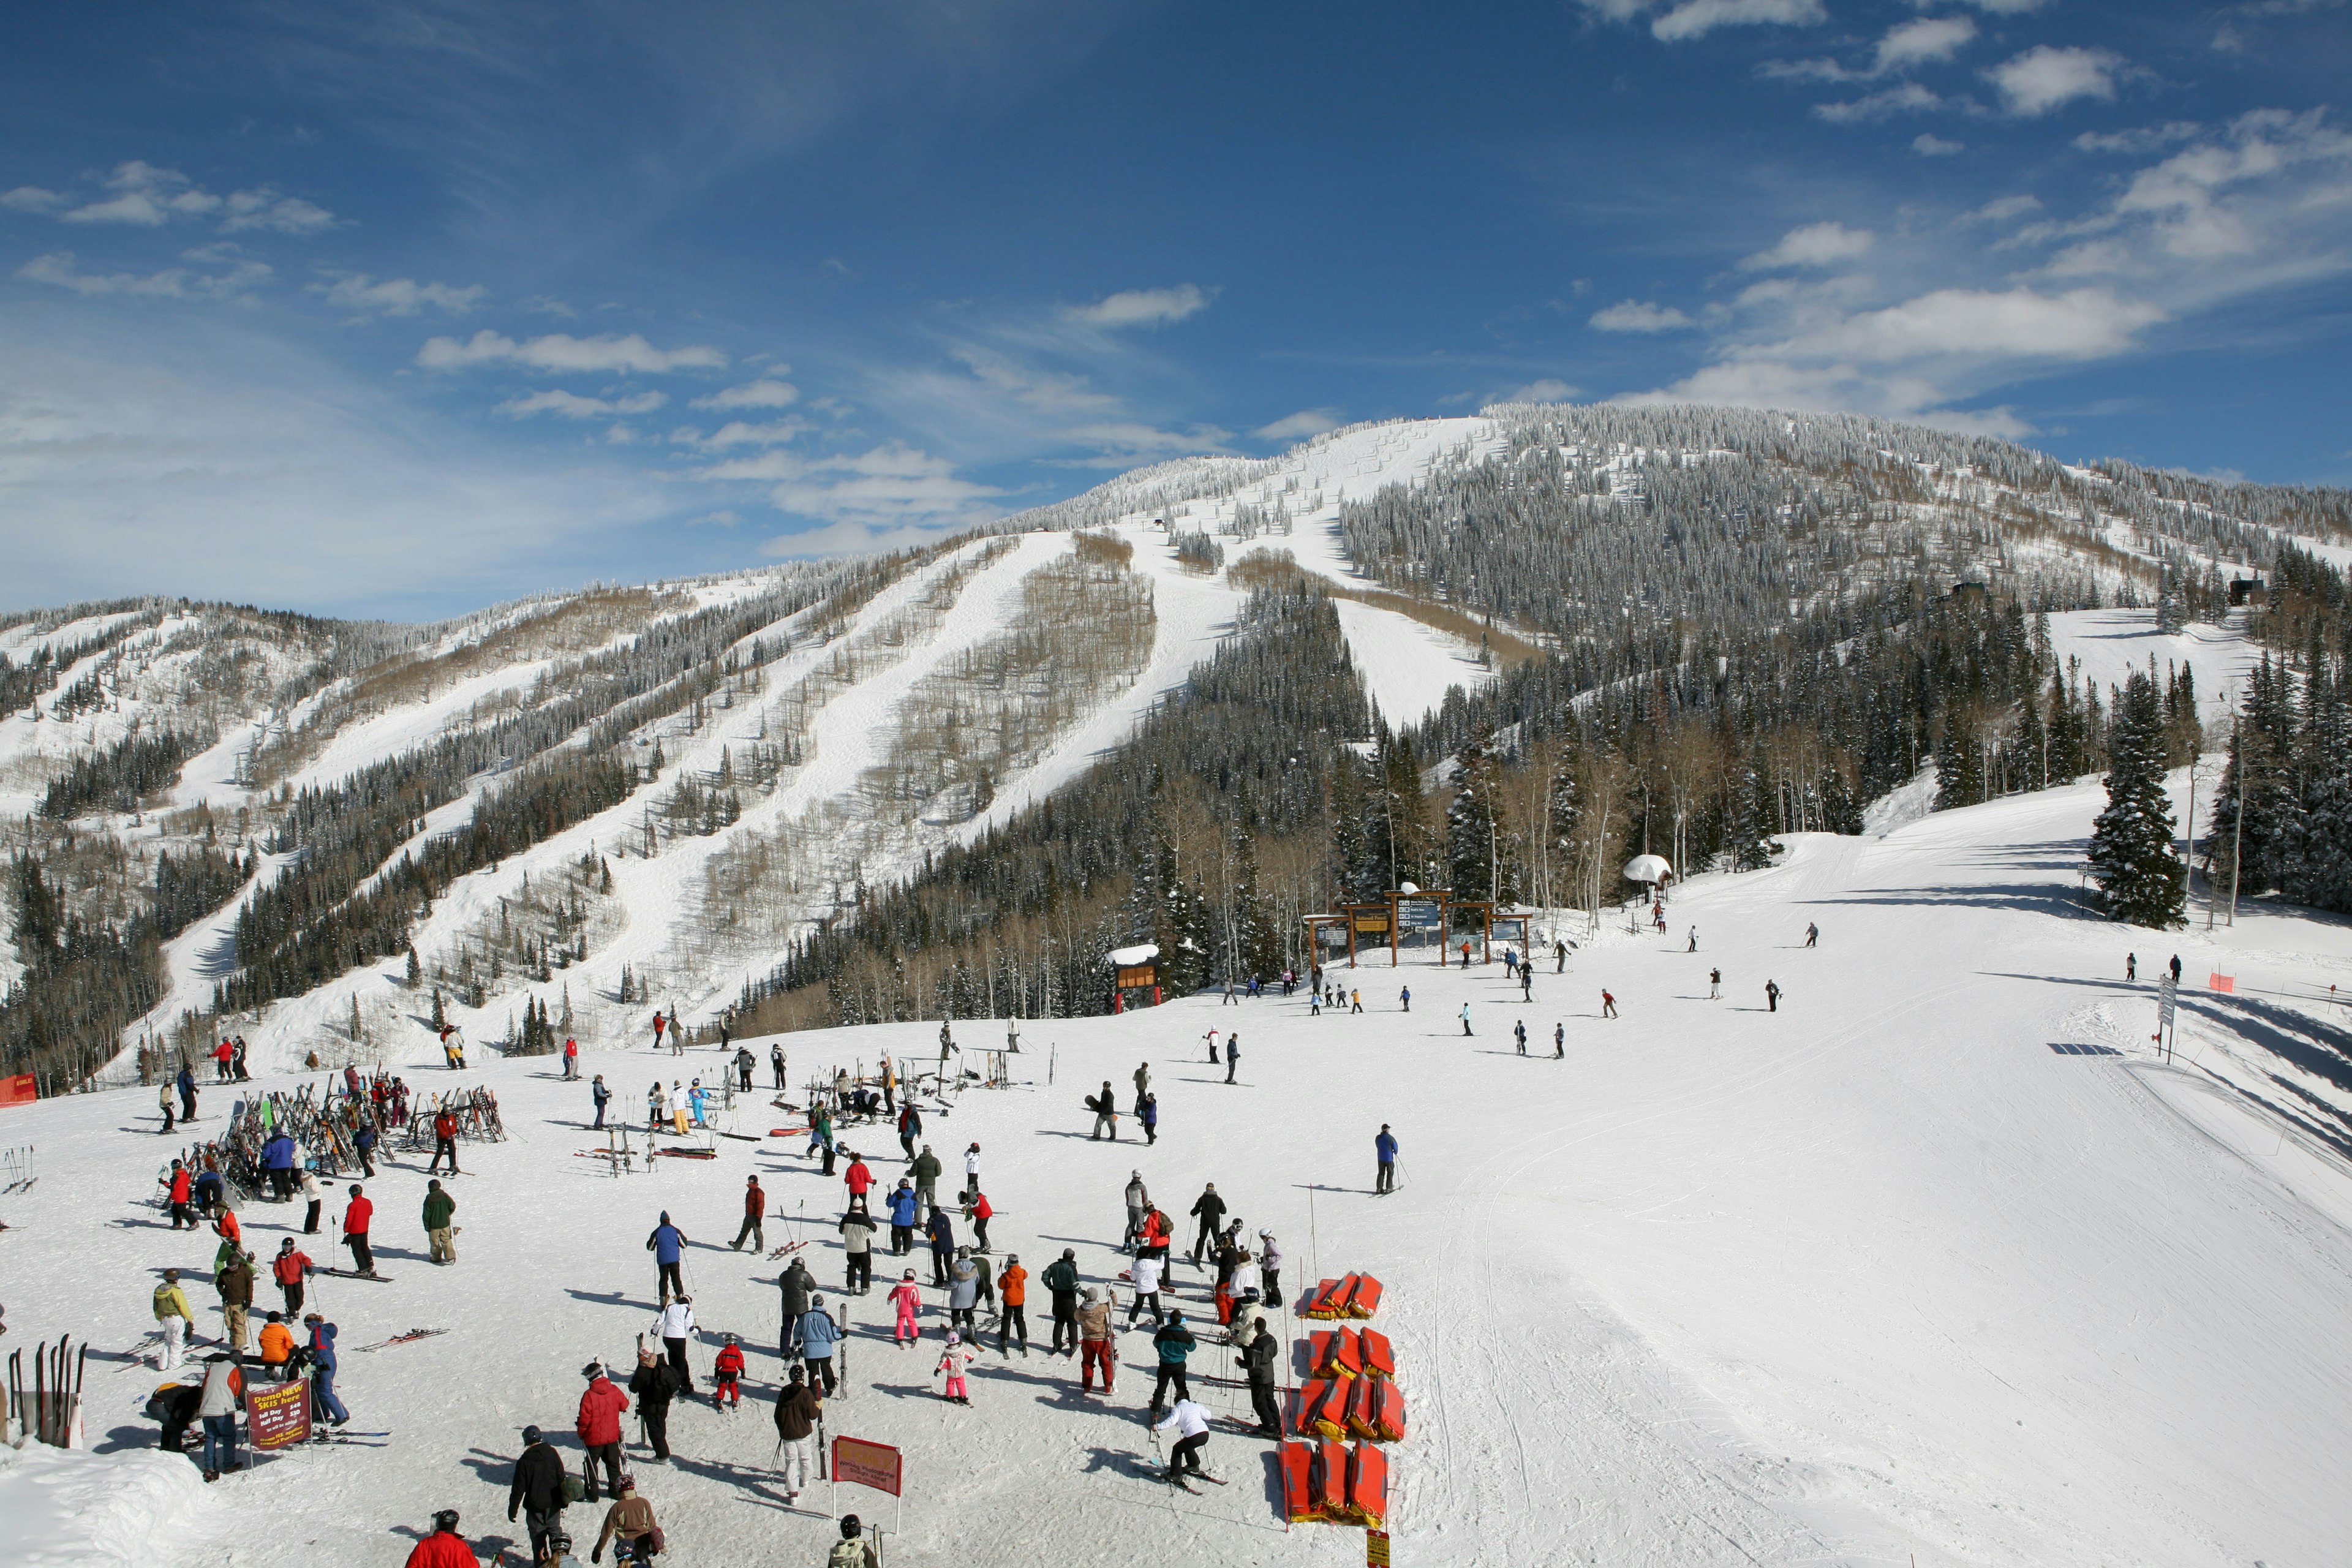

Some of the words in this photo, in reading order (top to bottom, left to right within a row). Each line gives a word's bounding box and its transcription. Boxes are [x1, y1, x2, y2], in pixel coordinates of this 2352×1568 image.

[254, 1392, 281, 1404] Demo
[282, 1384, 303, 1396] NEW
[258, 1400, 277, 1411] SKIS
[281, 1395, 300, 1404] here
[290, 1402, 301, 1411] $48
[260, 1418, 271, 1427] Half
[839, 1460, 860, 1471] Working
[862, 1466, 895, 1479] Photographer
[850, 1467, 869, 1476] Straight
